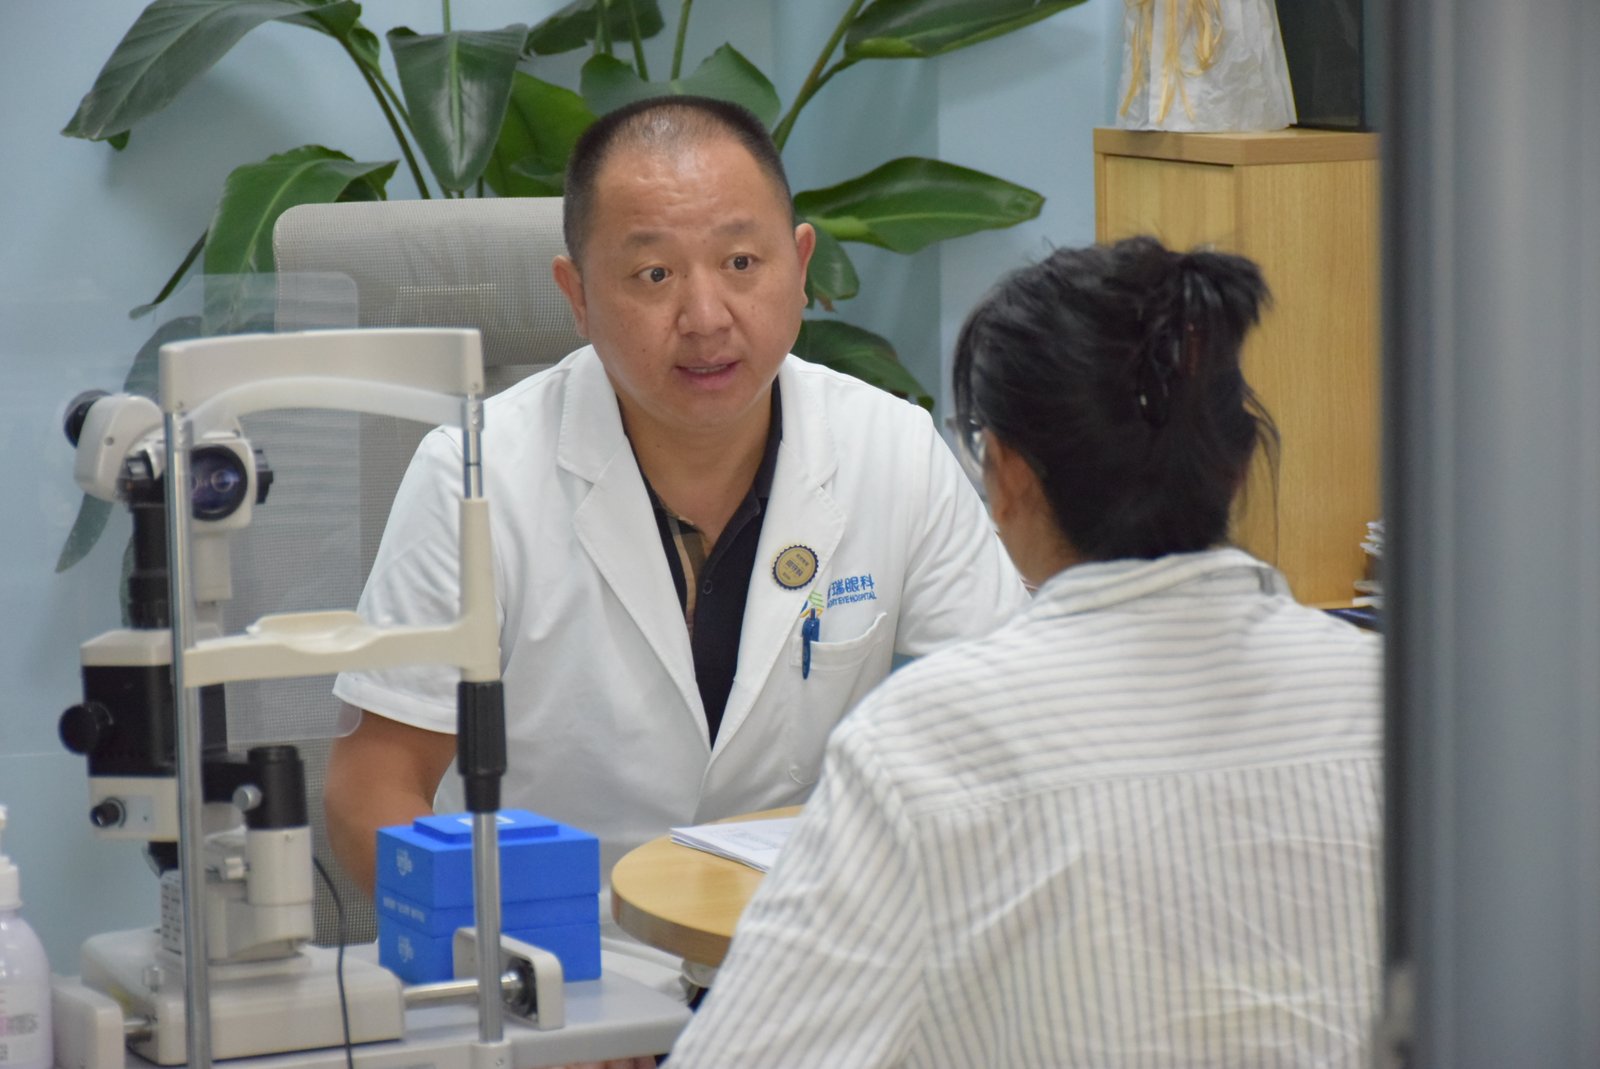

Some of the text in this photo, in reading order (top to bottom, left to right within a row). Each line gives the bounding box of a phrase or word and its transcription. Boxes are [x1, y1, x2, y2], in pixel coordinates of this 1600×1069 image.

[827, 574, 875, 598] 瑞眼科
[850, 591, 877, 603] HOSPITAL
